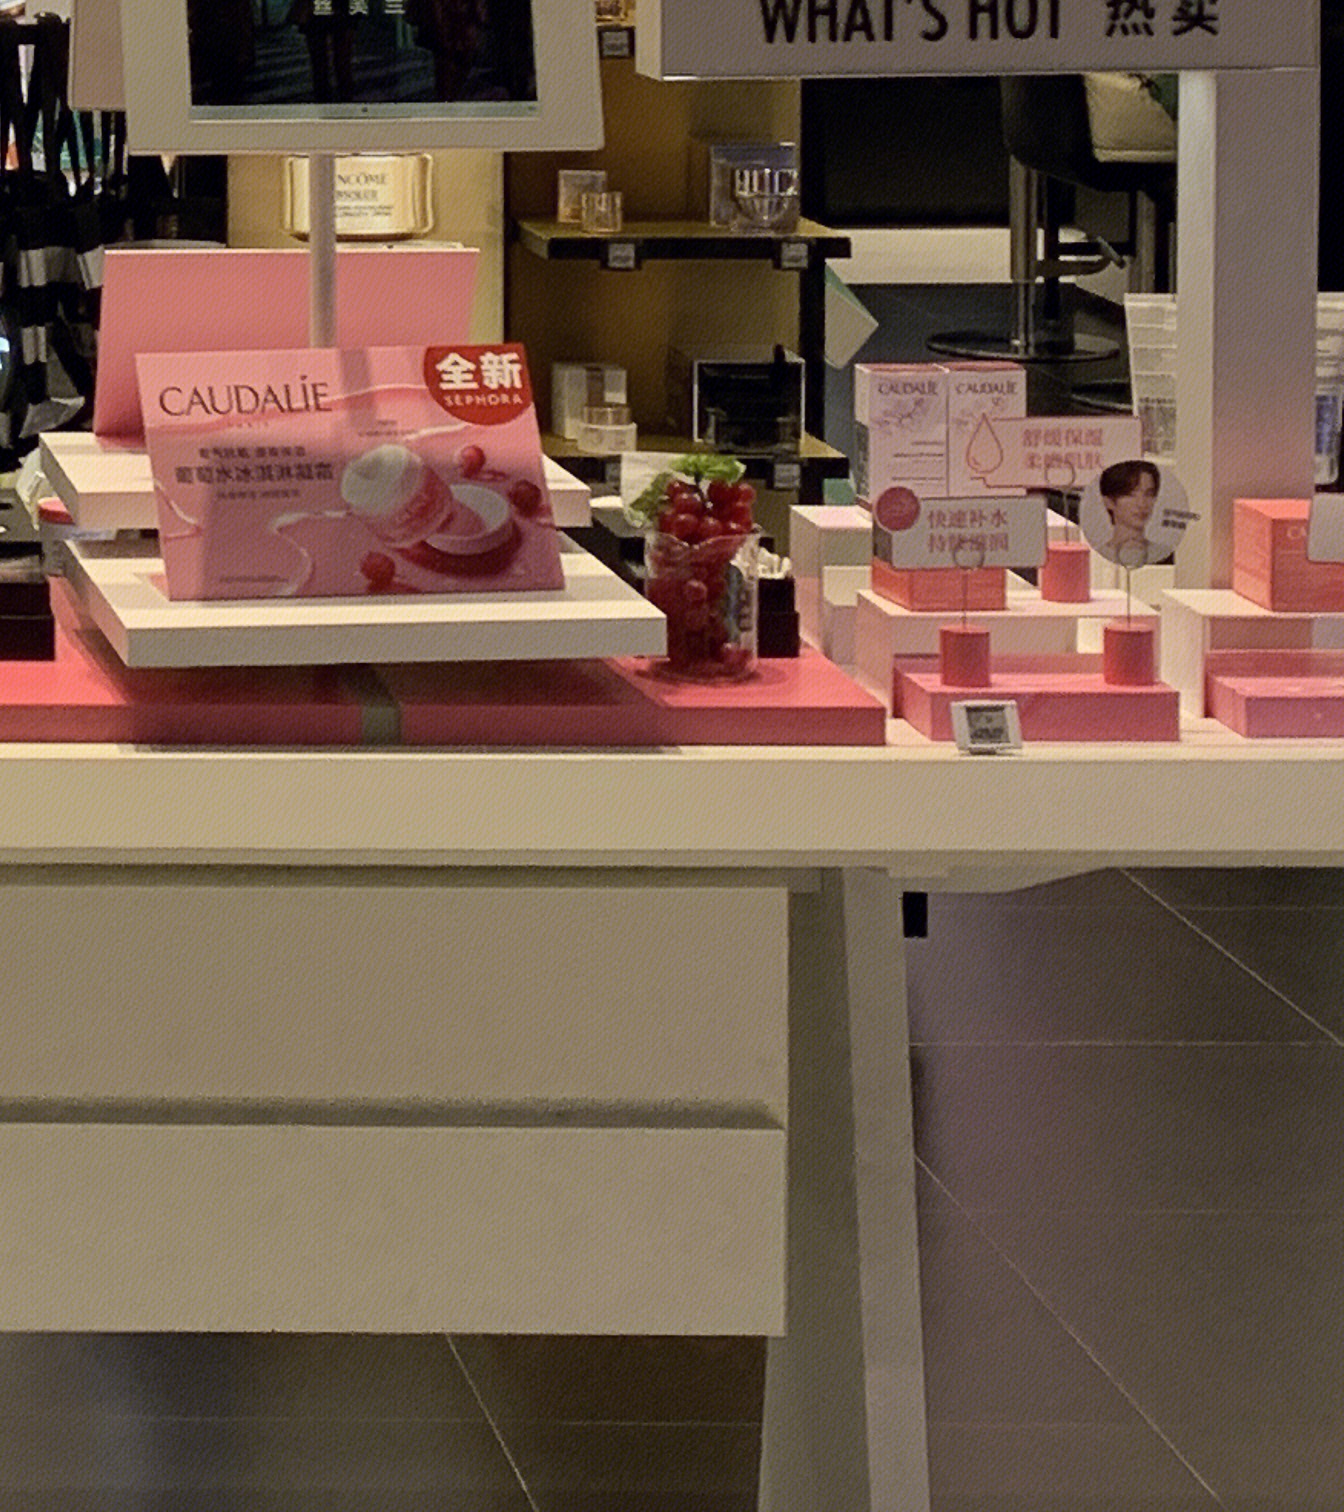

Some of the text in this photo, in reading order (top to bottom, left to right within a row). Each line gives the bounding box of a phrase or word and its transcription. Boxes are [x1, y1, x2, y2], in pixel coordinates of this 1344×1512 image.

[435, 351, 524, 390] 全新
[444, 393, 524, 407] SEPHORA
[927, 508, 1009, 528] 快速补水
